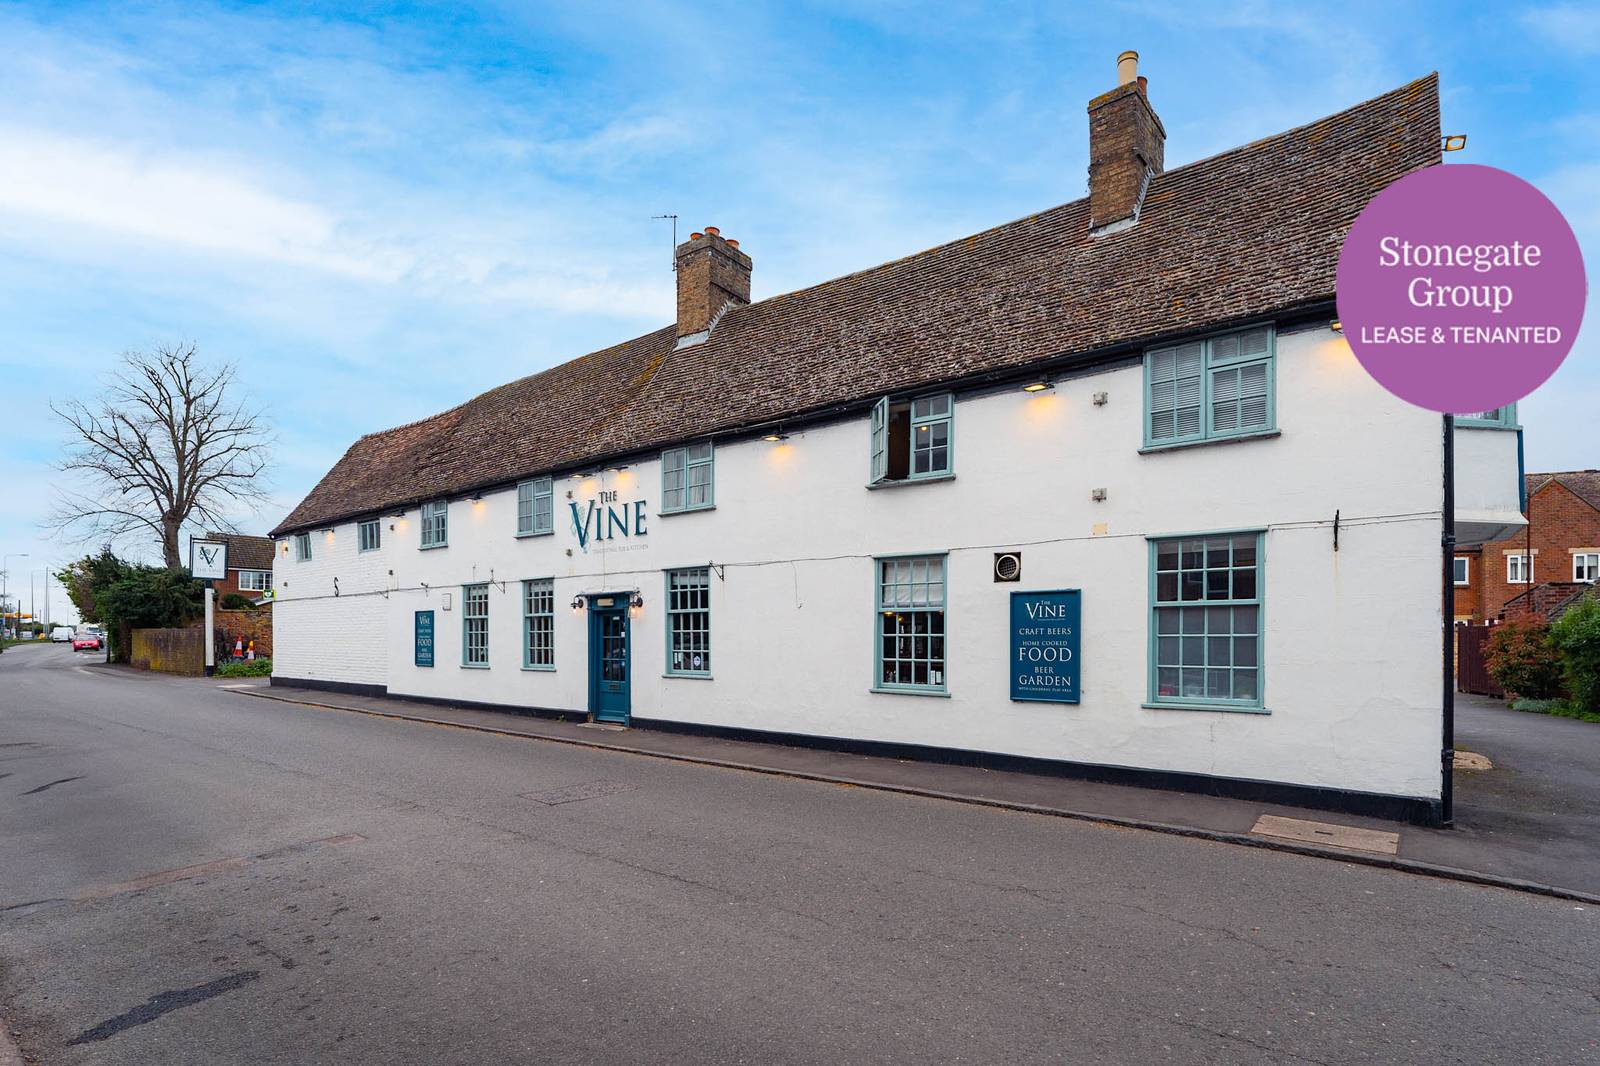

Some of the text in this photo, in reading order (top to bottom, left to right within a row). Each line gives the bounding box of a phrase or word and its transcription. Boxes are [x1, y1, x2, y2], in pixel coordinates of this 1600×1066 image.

[599, 490, 617, 504] THE
[568, 499, 649, 549] VINE
[1025, 602, 1066, 619] VINE
[1018, 627, 1072, 636] CRAFT BEERS
[1018, 646, 1072, 662] FOOD
[1034, 666, 1054, 674] BEER
[1018, 674, 1072, 686] GARDEN
